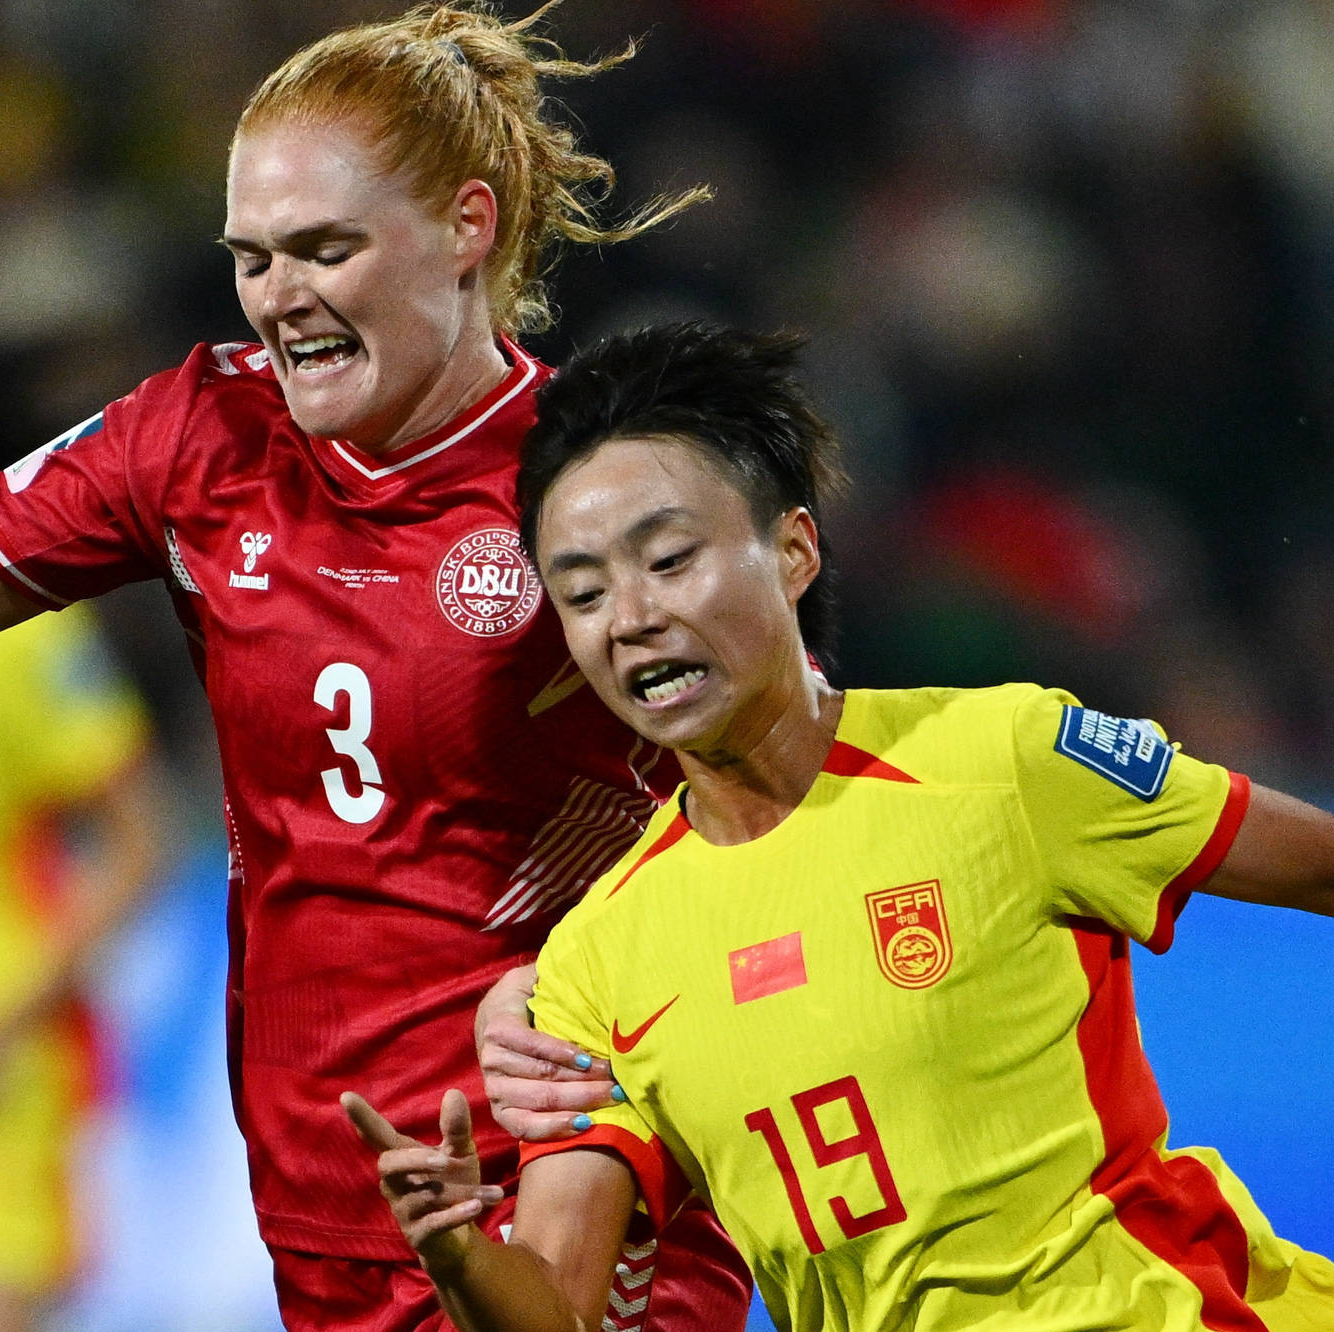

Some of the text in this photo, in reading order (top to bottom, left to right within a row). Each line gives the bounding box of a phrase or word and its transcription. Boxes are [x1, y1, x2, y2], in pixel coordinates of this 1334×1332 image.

[441, 557, 463, 620] DANSK
[458, 564, 522, 597] DBU
[465, 618, 507, 633] 1889
[313, 662, 385, 824] 3
[875, 890, 935, 919] CFA
[896, 912, 920, 926] 中国
[744, 1075, 908, 1255] 19
